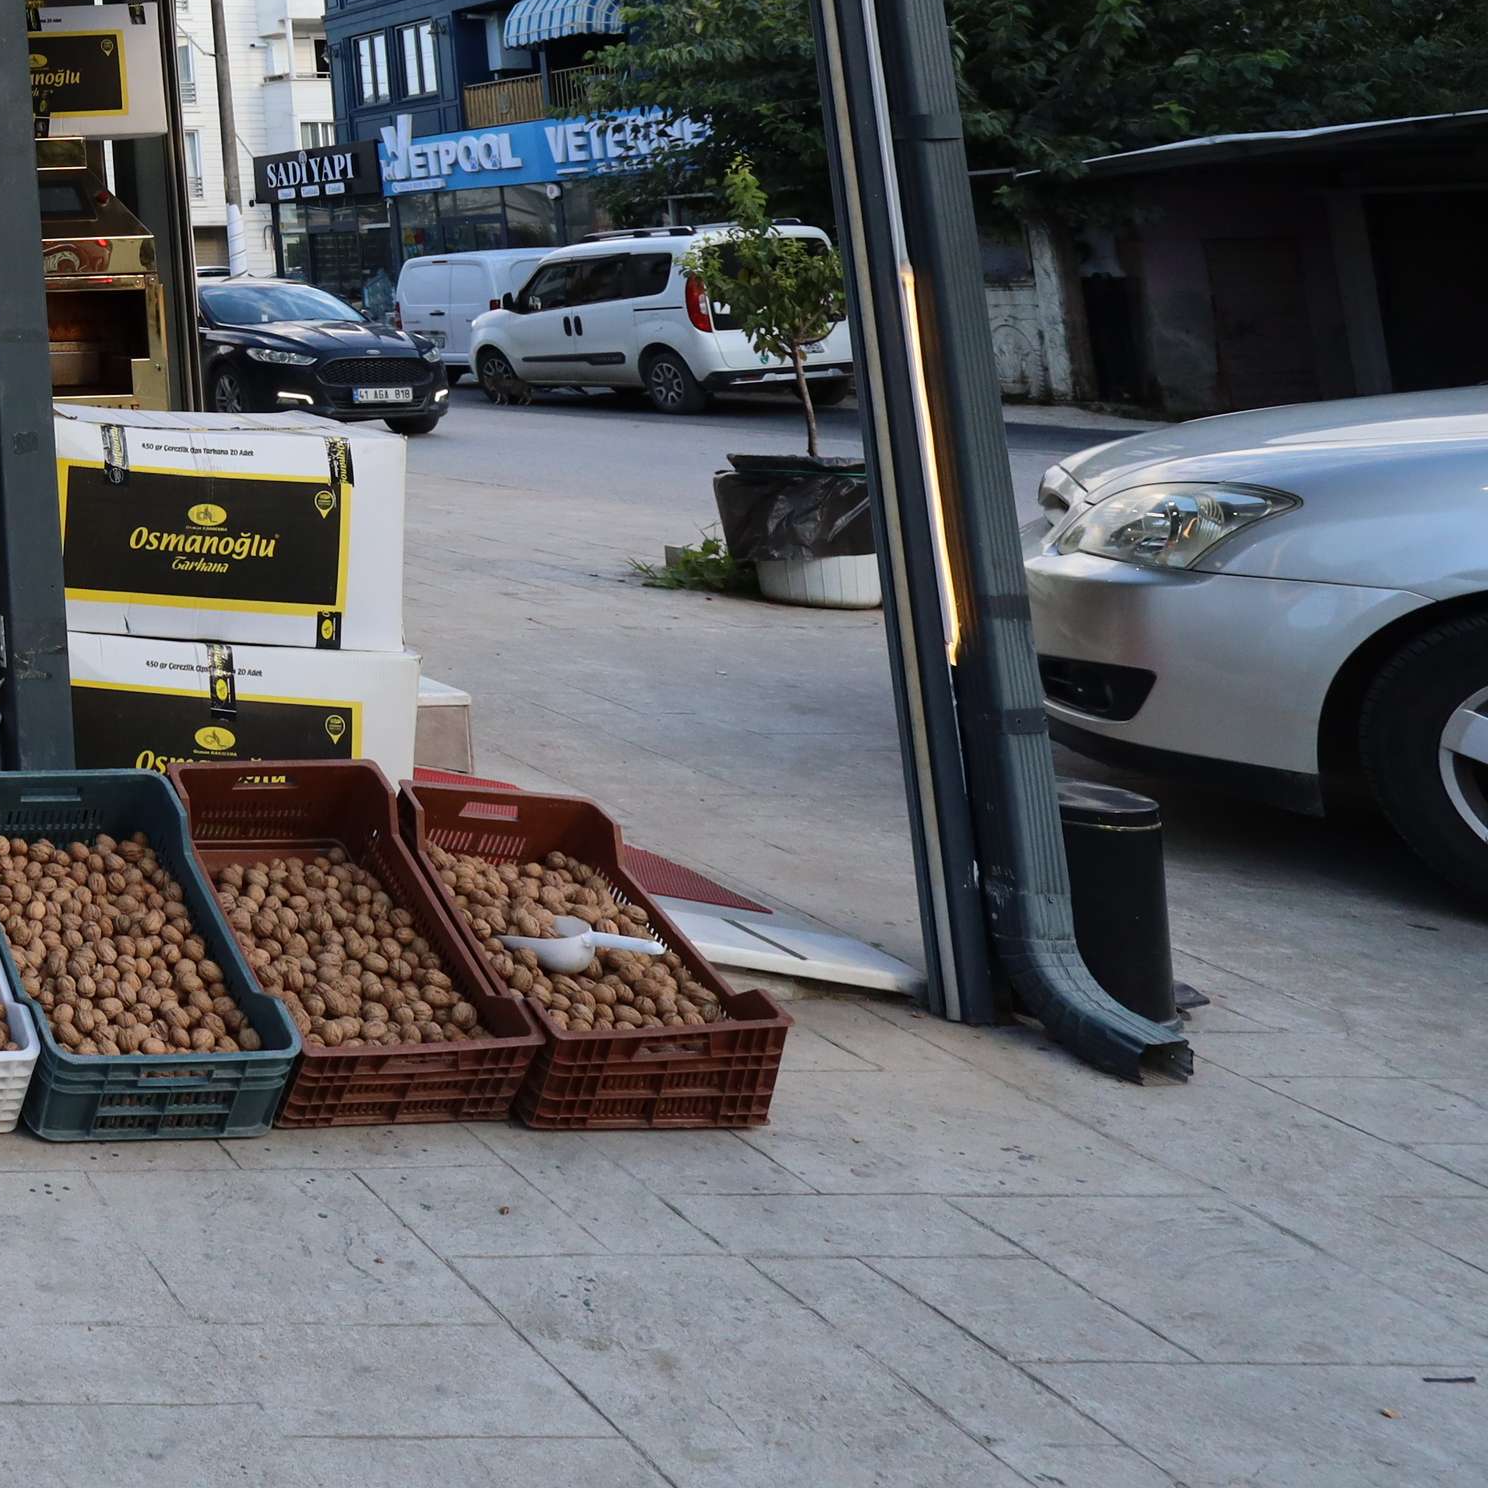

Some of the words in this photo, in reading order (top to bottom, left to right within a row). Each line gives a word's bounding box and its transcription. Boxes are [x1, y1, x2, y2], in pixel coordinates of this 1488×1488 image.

[30, 69, 81, 88] noğlu
[308, 153, 355, 183] YAPI
[358, 388, 368, 401] 41
[239, 449, 254, 457] Adet
[129, 526, 276, 560] Osmanoğlu
[171, 555, 229, 573] Tarhana
[247, 668, 263, 677] Adet
